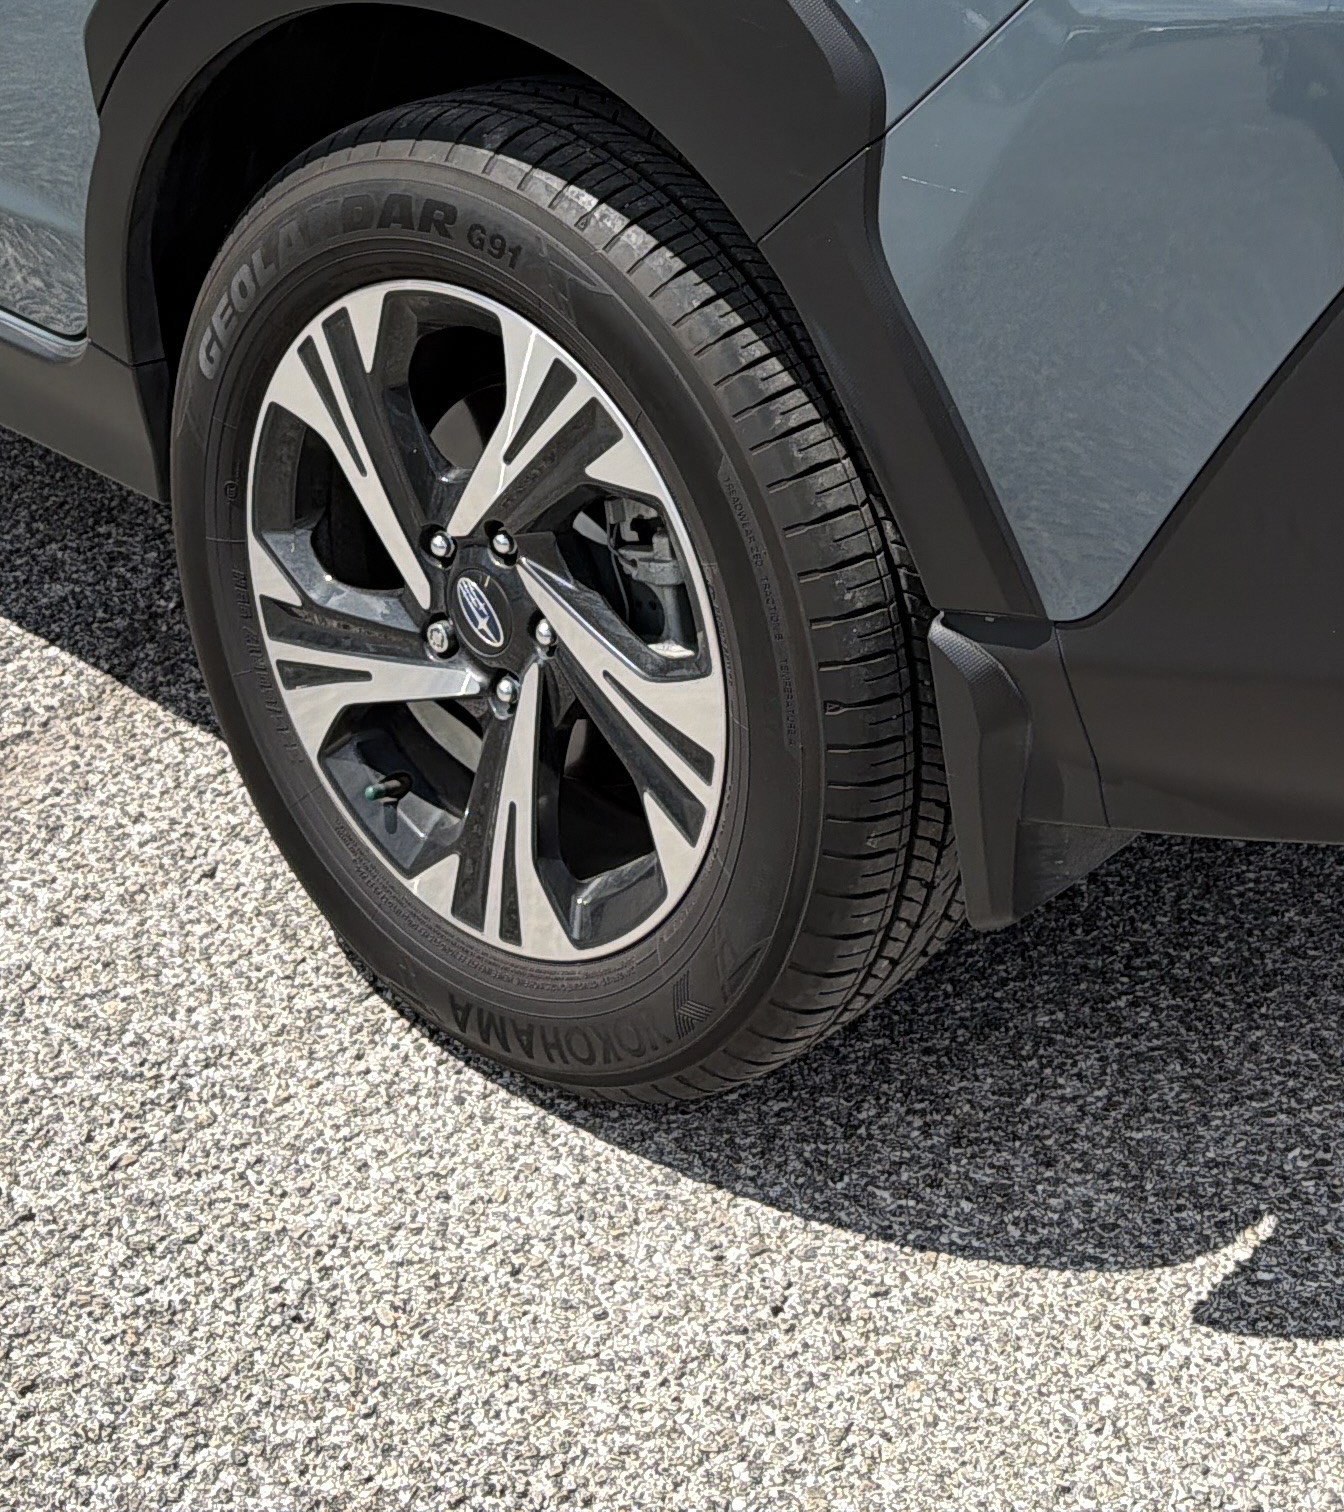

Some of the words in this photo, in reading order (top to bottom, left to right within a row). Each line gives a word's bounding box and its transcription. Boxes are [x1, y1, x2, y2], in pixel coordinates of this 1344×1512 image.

[198, 192, 458, 380] GEOLANDAR
[466, 223, 523, 270] G91
[449, 991, 674, 1066] YOKOHAMA
